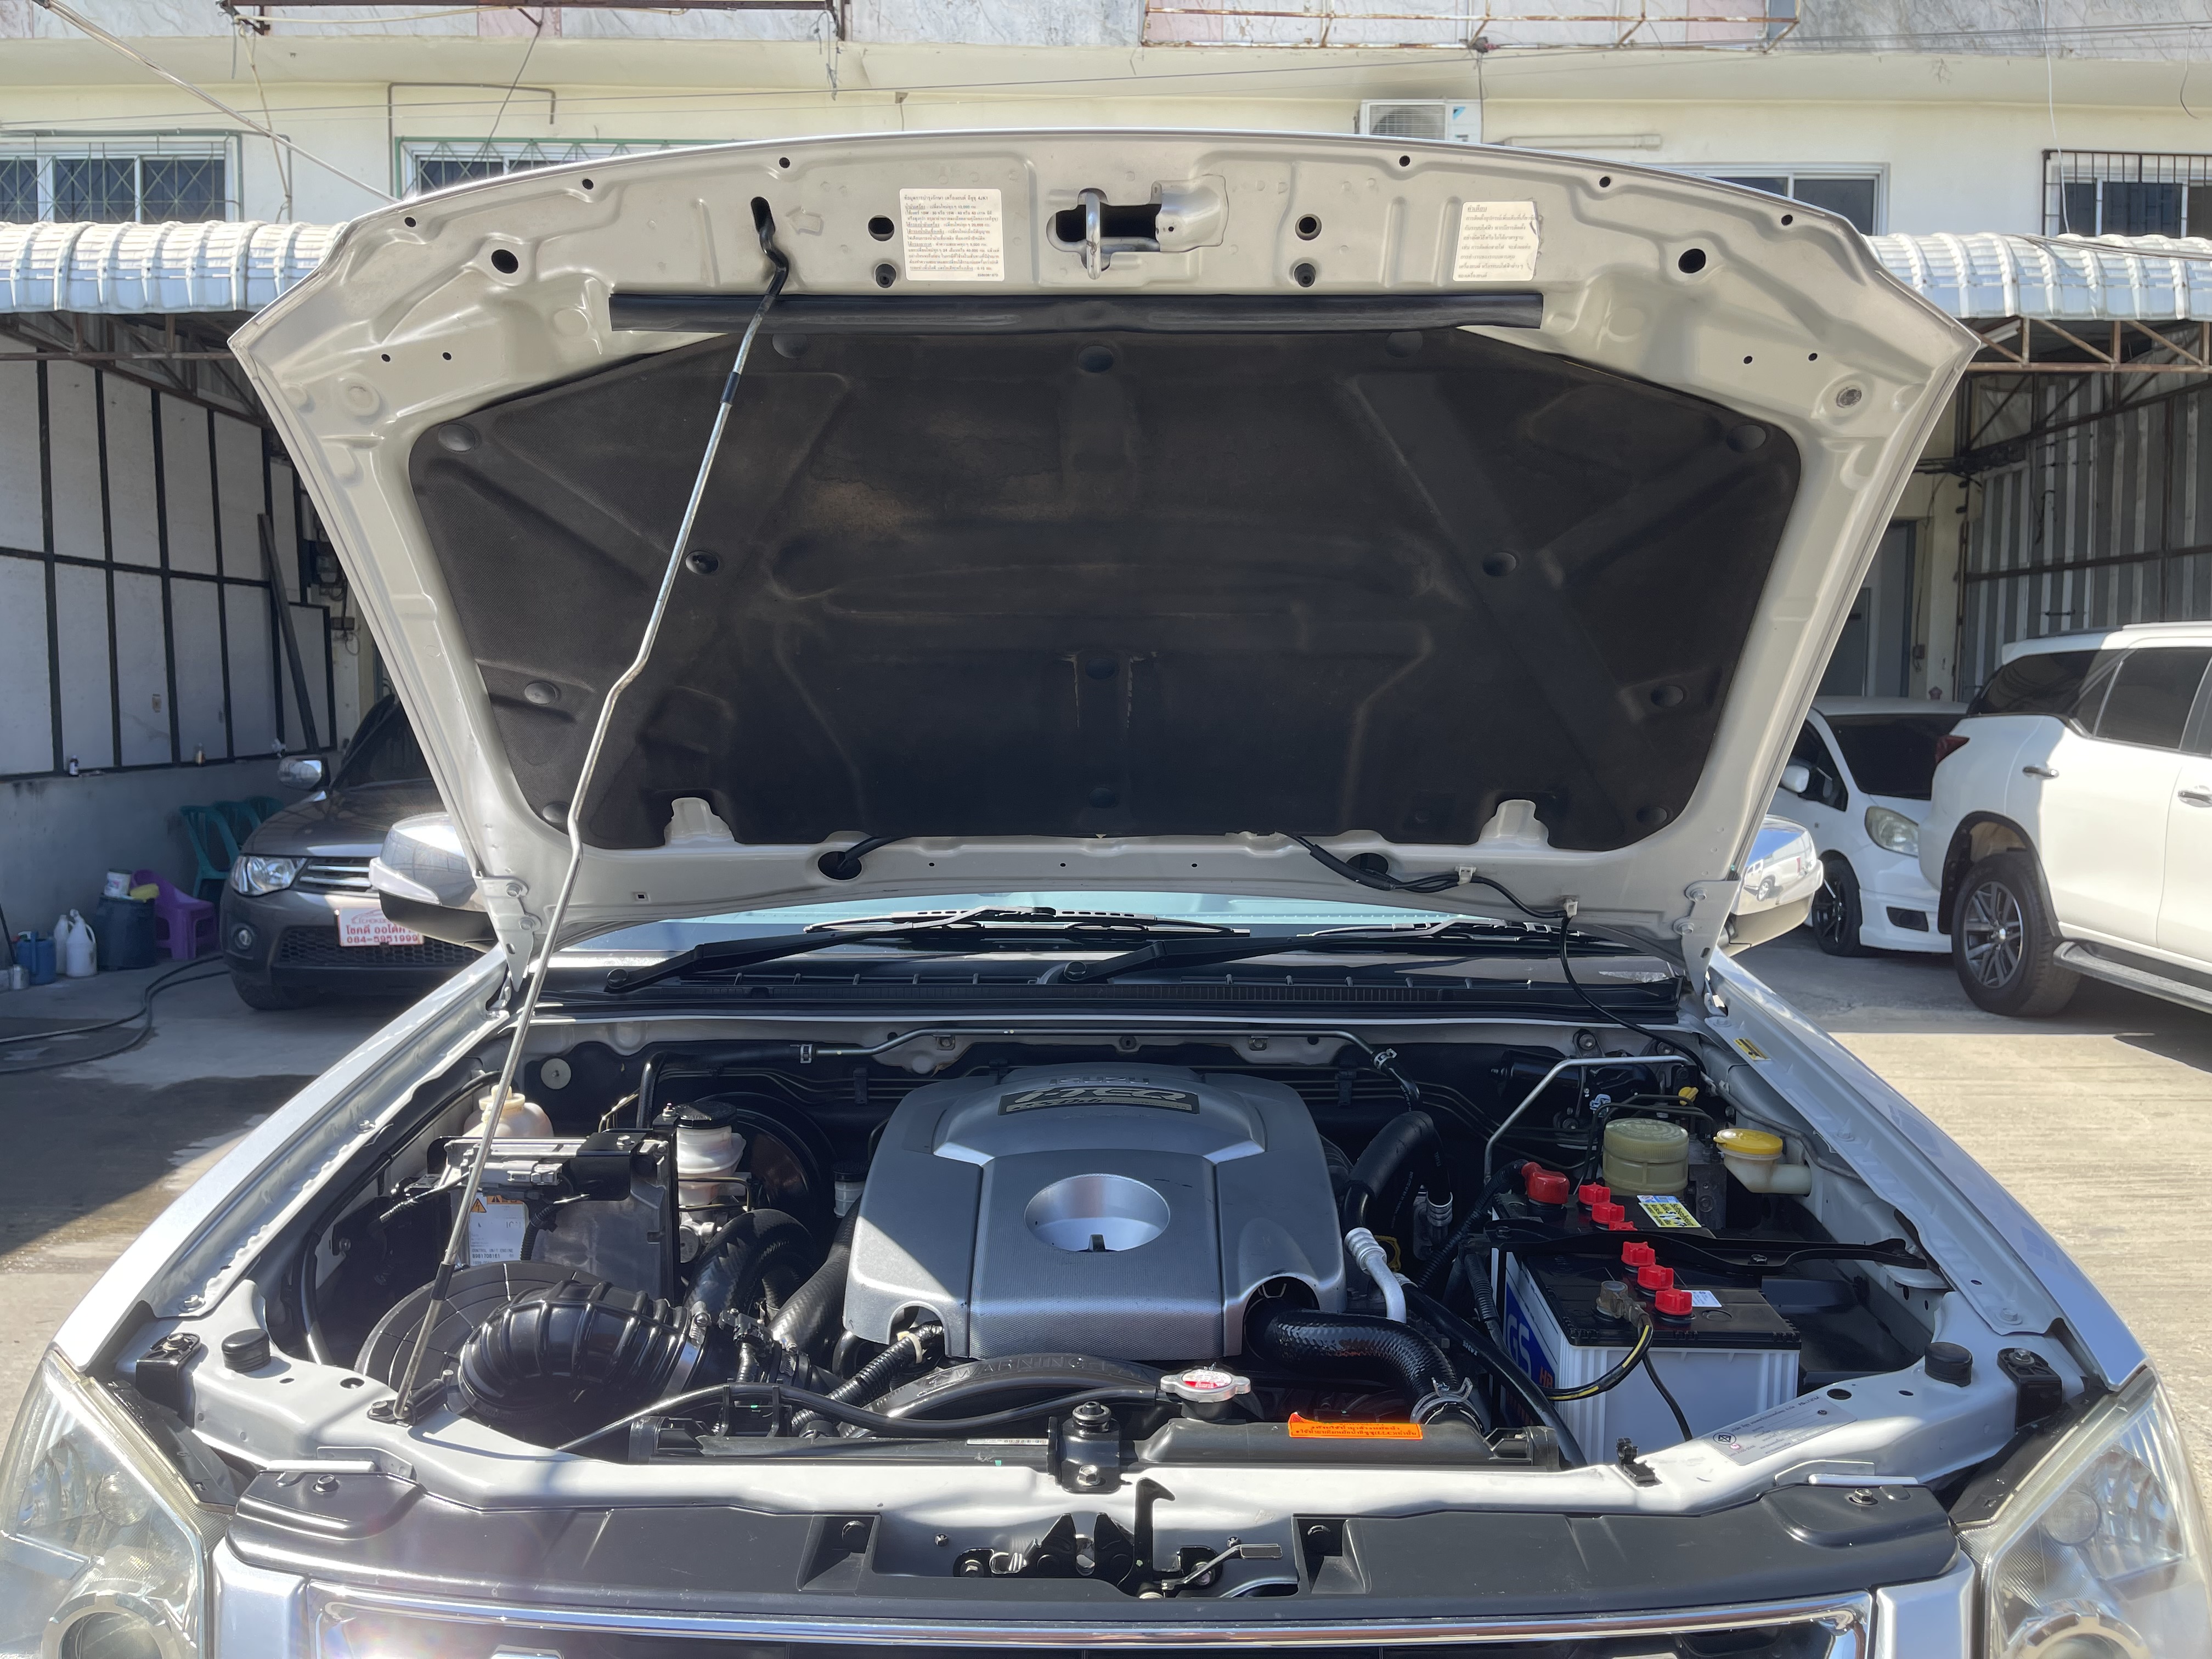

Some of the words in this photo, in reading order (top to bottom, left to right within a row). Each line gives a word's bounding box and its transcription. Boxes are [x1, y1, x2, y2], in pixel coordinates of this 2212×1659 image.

[347, 934, 418, 943] 084-5951999
[1049, 1076, 1149, 1085] ISUZU
[1507, 1314, 1532, 1379] GS
[1798, 1396, 1819, 1406] ISUZU
